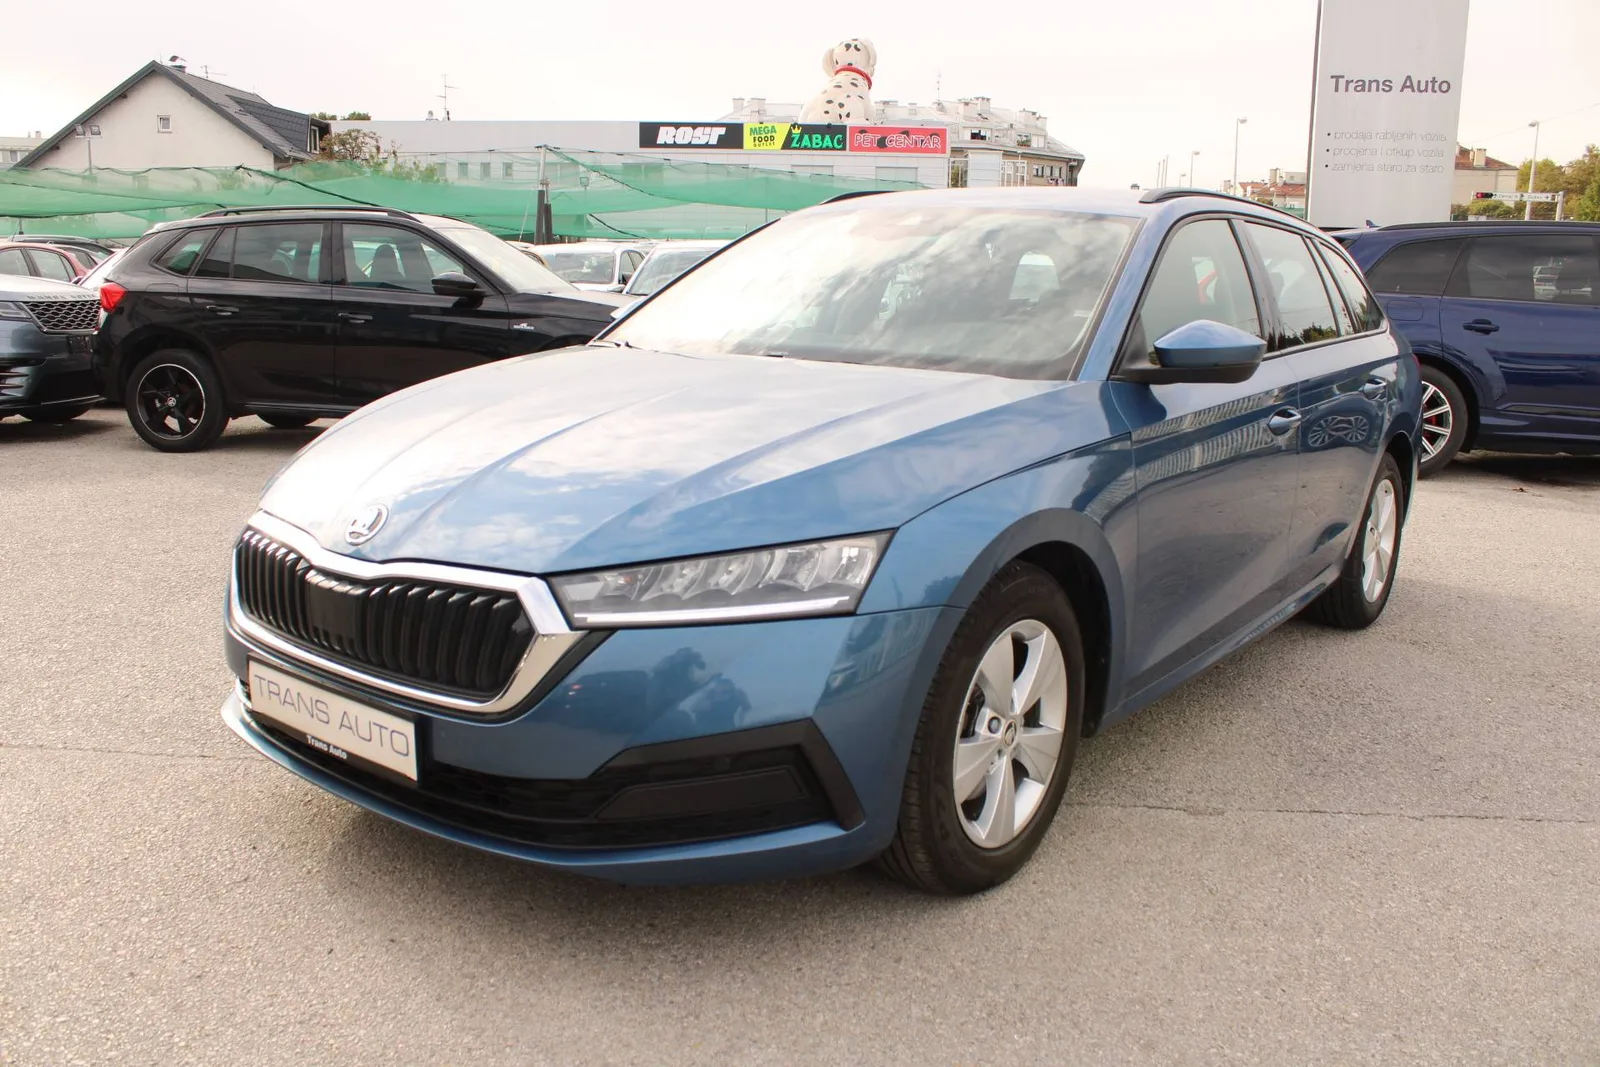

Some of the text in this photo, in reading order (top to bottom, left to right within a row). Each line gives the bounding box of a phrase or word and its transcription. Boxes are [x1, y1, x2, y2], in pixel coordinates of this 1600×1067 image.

[1330, 75, 1451, 94] Trans Auto
[656, 126, 727, 145] ROST
[749, 125, 777, 136] MEGA
[1333, 130, 1373, 142] prodaja
[1420, 131, 1447, 142] vozila
[753, 135, 775, 143] FOOD
[854, 133, 942, 148] PET CENTAR
[1386, 147, 1415, 159] otkup
[1418, 147, 1444, 158] vozila
[1377, 162, 1403, 173] staro
[1405, 164, 1417, 173] za
[1420, 164, 1445, 174] staro
[254, 674, 410, 757] TRANS AUTO
[306, 734, 347, 760] Trans Auto
